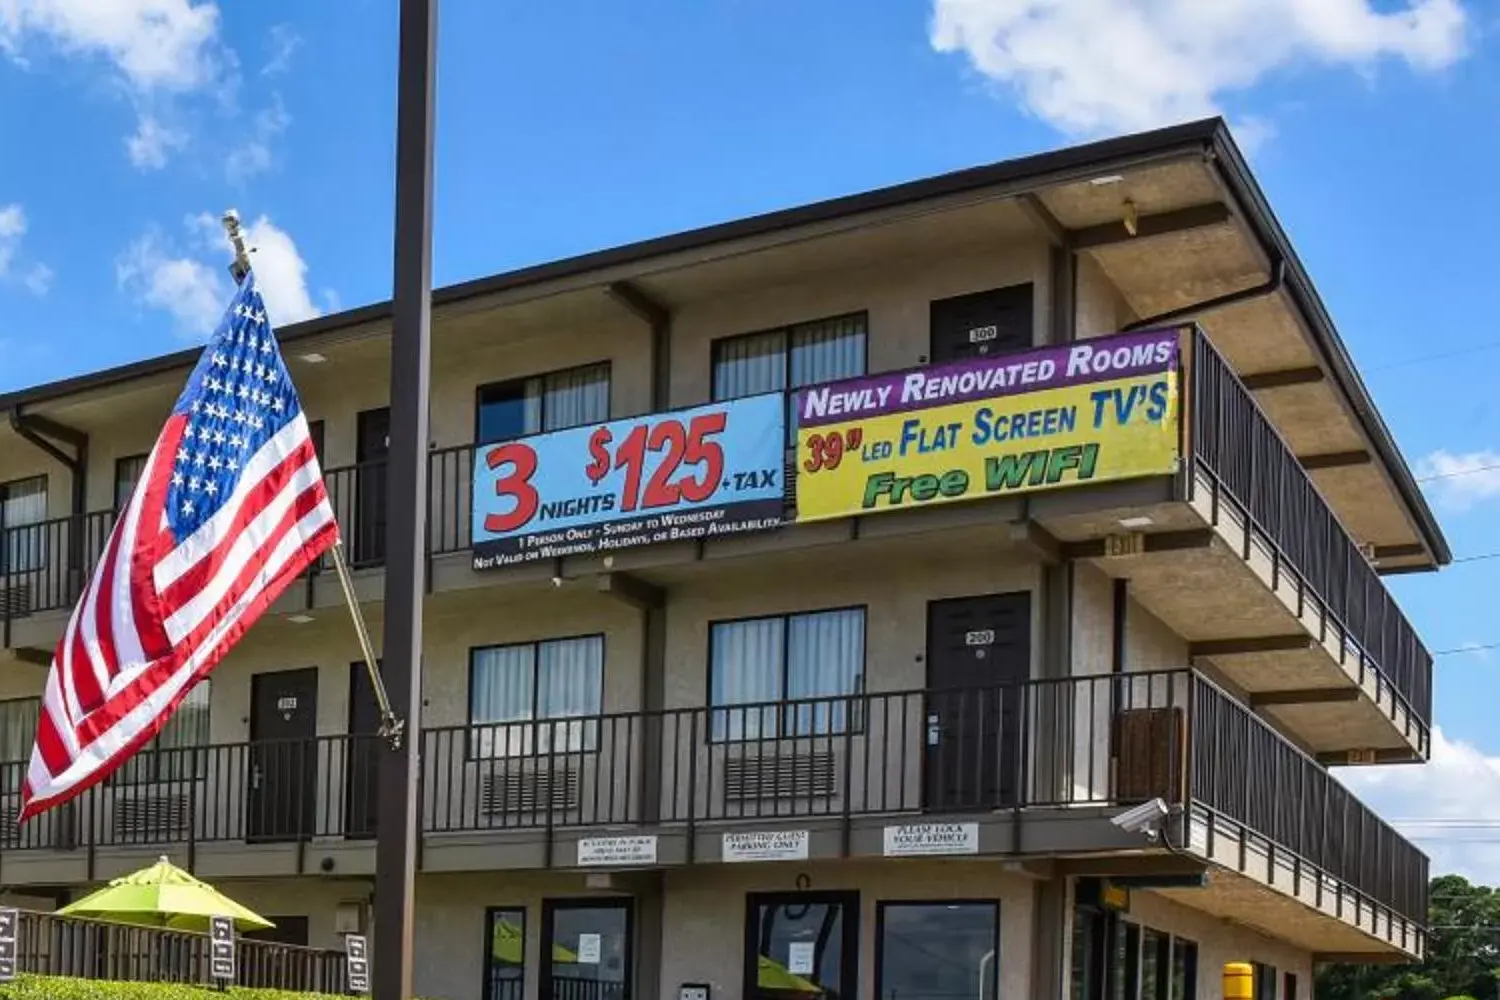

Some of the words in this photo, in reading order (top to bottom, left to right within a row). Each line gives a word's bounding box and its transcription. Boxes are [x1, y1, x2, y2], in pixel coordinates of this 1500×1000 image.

[804, 384, 892, 419] NEWLY
[902, 358, 1055, 403] RENOVATED
[1066, 340, 1173, 378] ROOMS
[862, 440, 892, 462] LED
[899, 419, 963, 457] FLAT
[971, 406, 1078, 446] SCREEN
[1090, 381, 1168, 429] TV'S
[484, 442, 539, 534] 3
[539, 493, 616, 521] NIGHTS
[585, 412, 729, 512] $125
[862, 468, 969, 509] Free
[985, 443, 1100, 490] WIFI
